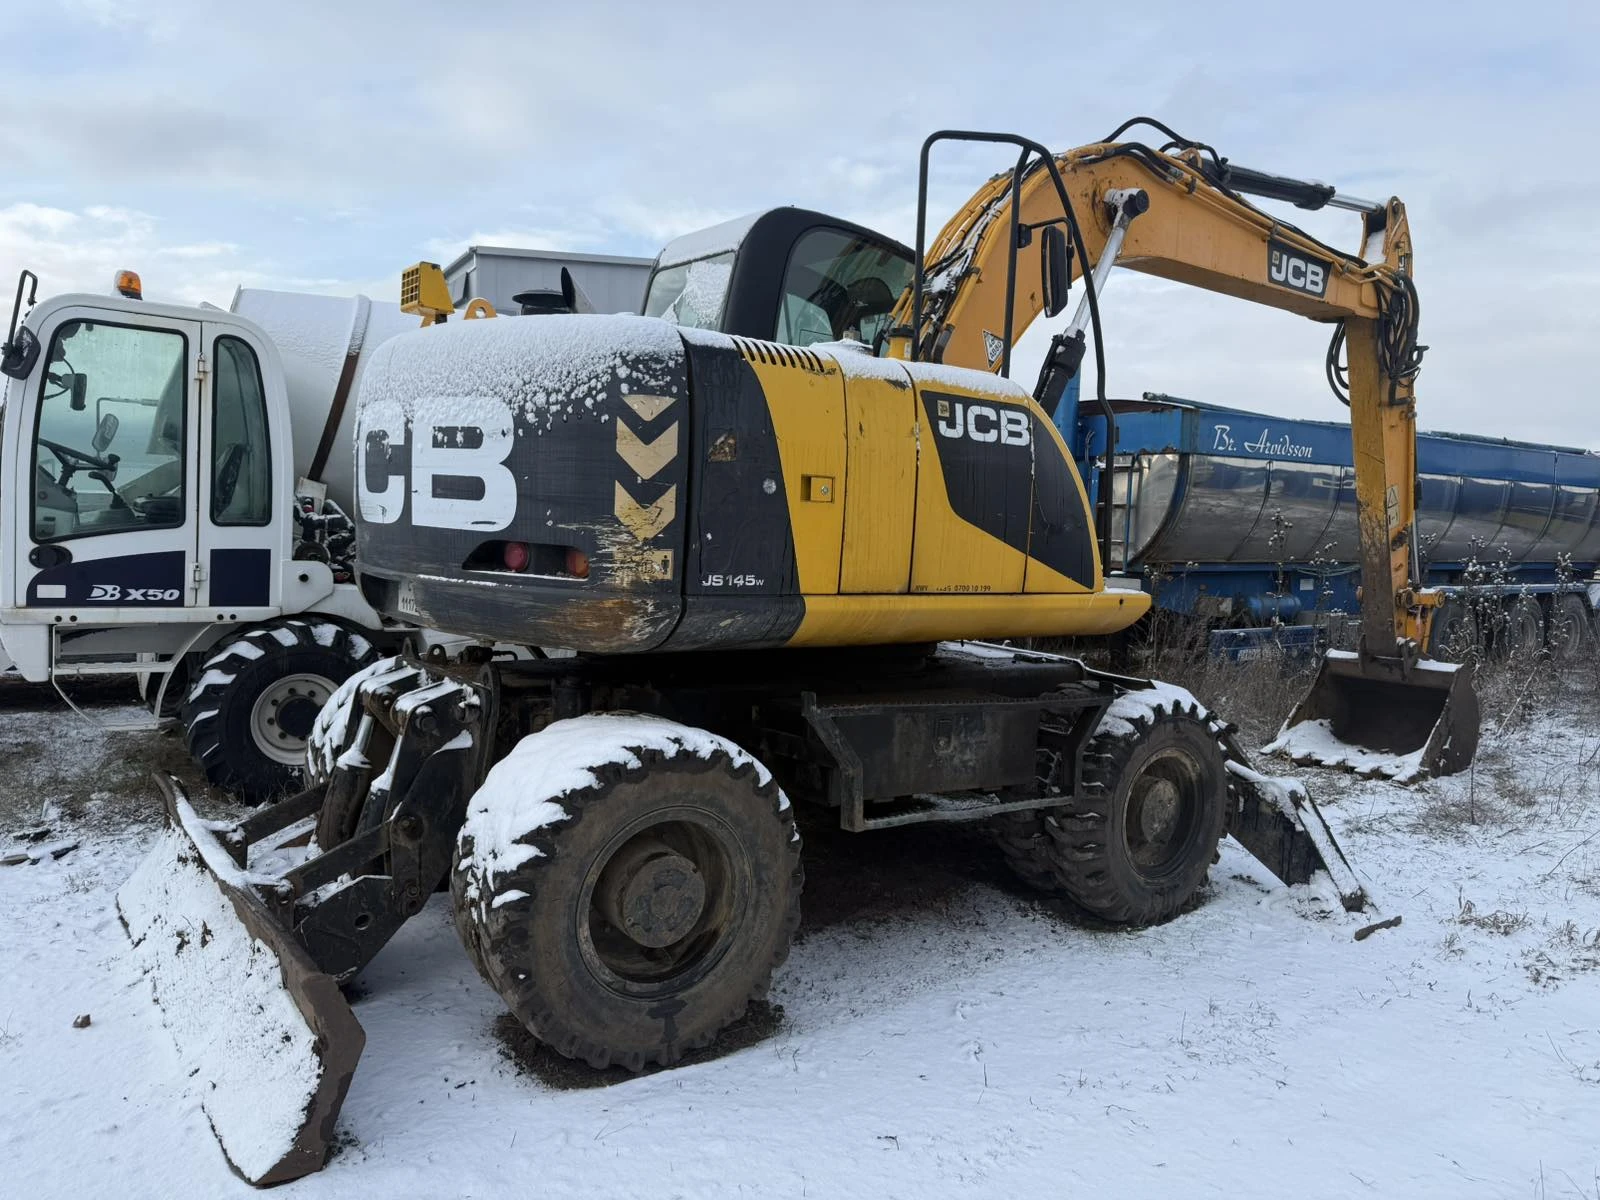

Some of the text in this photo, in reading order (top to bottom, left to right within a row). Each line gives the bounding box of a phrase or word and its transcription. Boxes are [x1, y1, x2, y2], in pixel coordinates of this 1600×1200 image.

[1271, 254, 1324, 293] JCB
[938, 402, 1031, 447] JCB
[1213, 424, 1313, 459] Br. Arvidsson
[123, 588, 181, 601] X50
